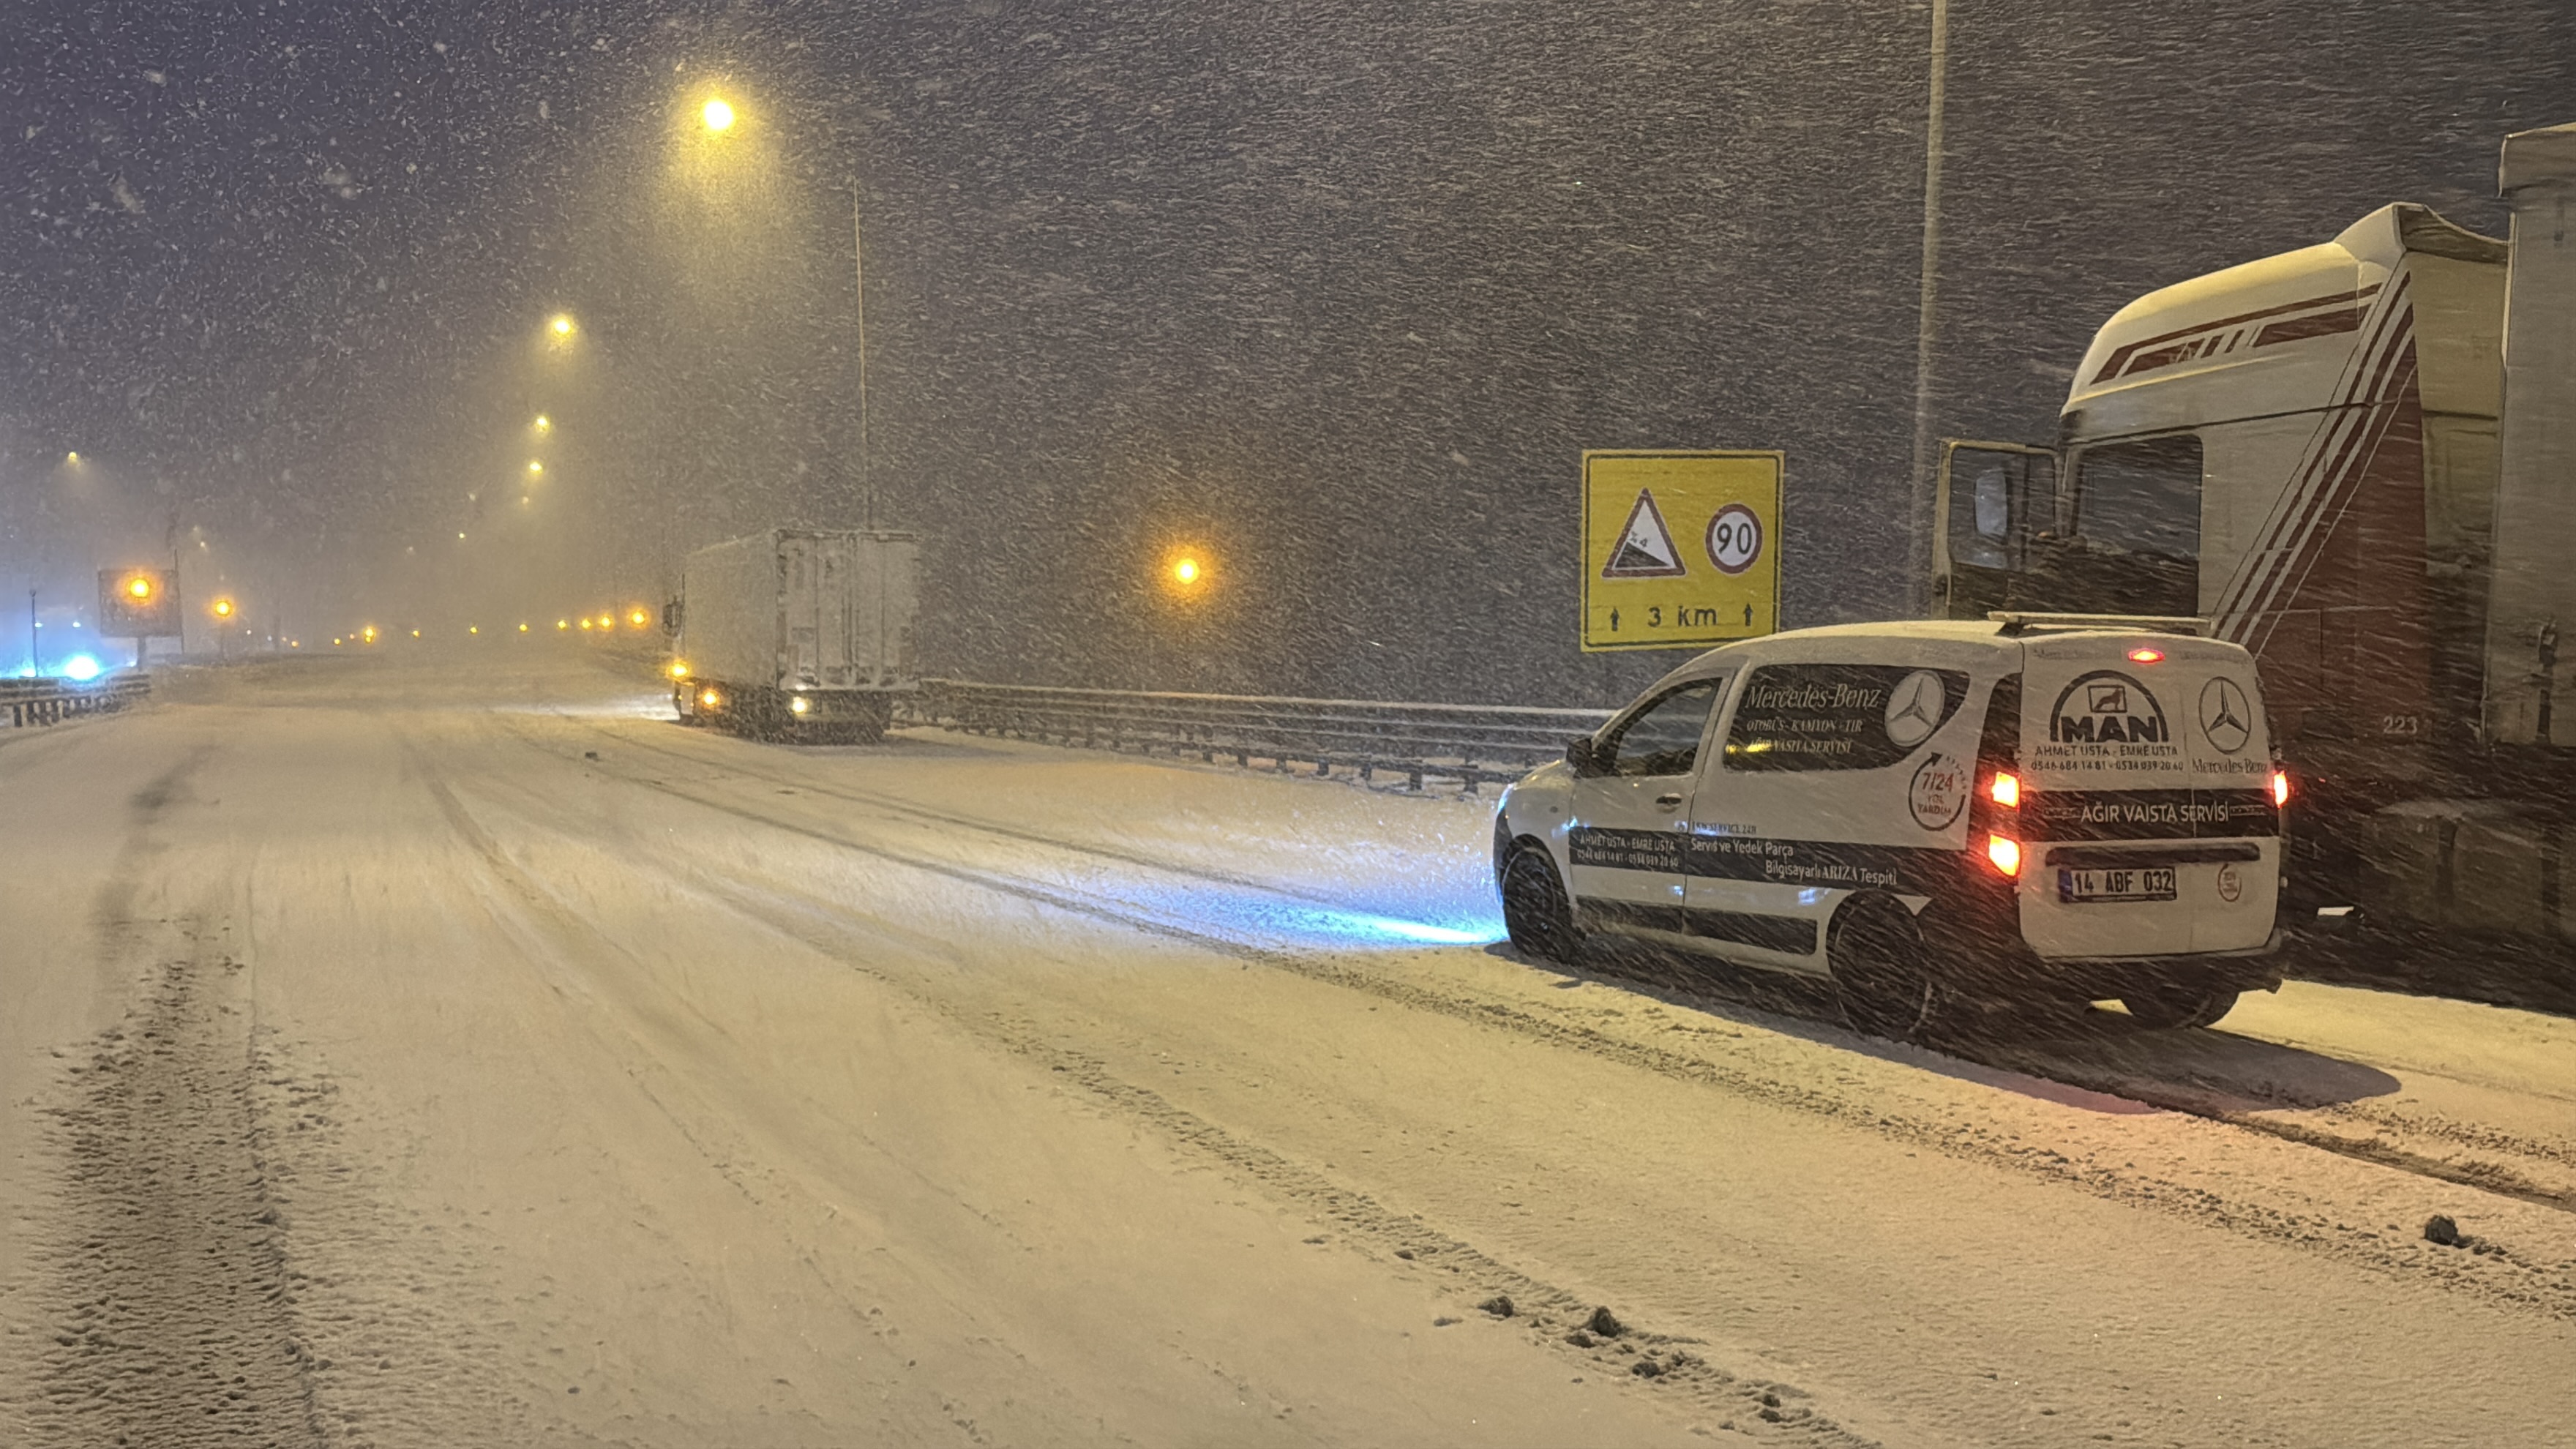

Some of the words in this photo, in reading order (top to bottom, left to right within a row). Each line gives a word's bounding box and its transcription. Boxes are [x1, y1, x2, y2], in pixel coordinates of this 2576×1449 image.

[1717, 523, 1753, 555] 90
[1647, 607, 1662, 627] 3
[1678, 605, 1717, 627] km
[1745, 684, 1882, 709] Mercedes-Benz
[2061, 716, 2159, 743] MAN
[2384, 716, 2417, 734] 223
[2034, 745, 2076, 757] AHMET
[2081, 745, 2111, 757] USTA
[2152, 745, 2178, 757] USTA
[1922, 772, 1953, 793] 7/24
[2081, 801, 2119, 823] AĞIR
[2122, 804, 2178, 823] VAISTA
[2181, 801, 2229, 823] SERVİSİ
[1691, 839, 1718, 853] Servis
[1720, 842, 1731, 853] ve
[1733, 839, 1763, 854] Yedek
[1765, 842, 1794, 858] Parça
[1821, 866, 1859, 882] ARIZA
[2074, 872, 2094, 893] 14
[2105, 871, 2134, 893] ABF
[2143, 869, 2173, 892] 032
